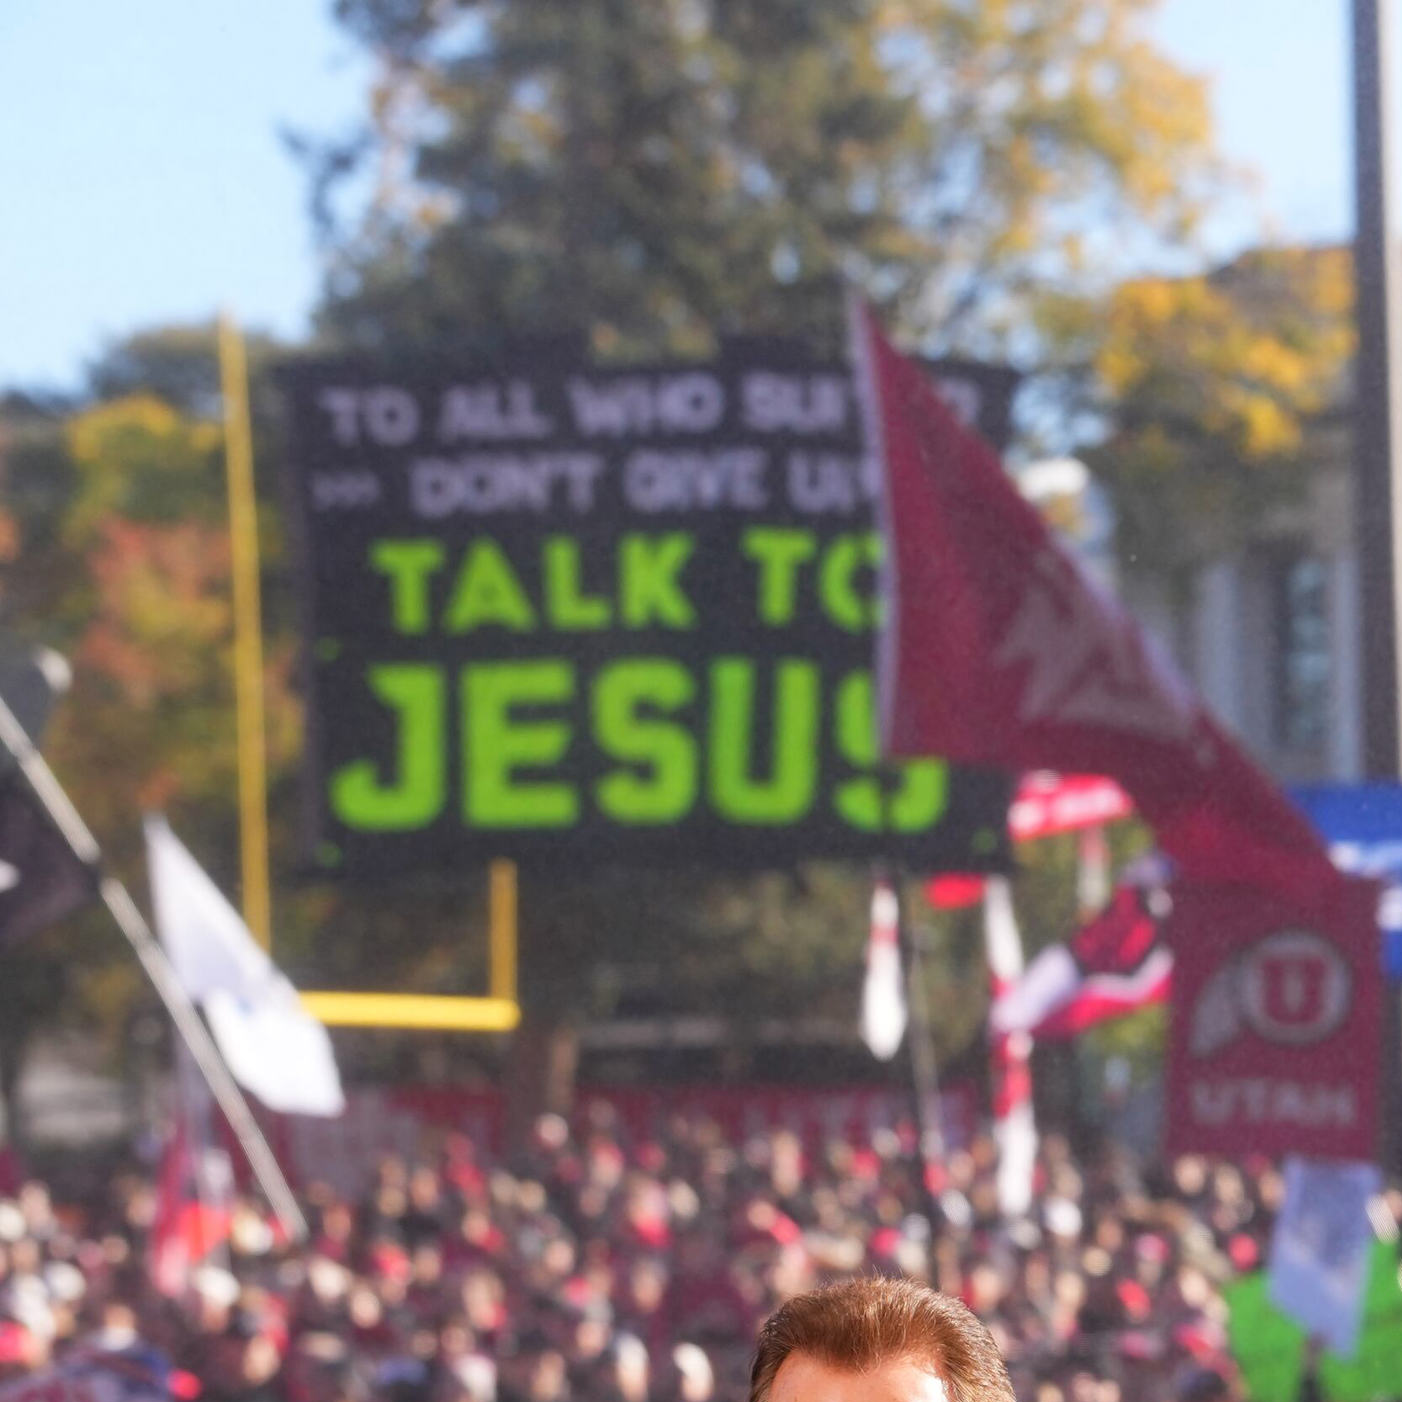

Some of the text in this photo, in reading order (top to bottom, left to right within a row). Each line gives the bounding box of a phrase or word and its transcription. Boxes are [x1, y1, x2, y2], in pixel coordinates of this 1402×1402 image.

[318, 387, 418, 447] TO
[439, 380, 554, 441] ALL
[567, 372, 722, 437] WHO
[622, 447, 768, 512] GIVE
[372, 531, 694, 633] TALK
[331, 655, 948, 832] JESUS
[1190, 1078, 1356, 1130] UTAH
